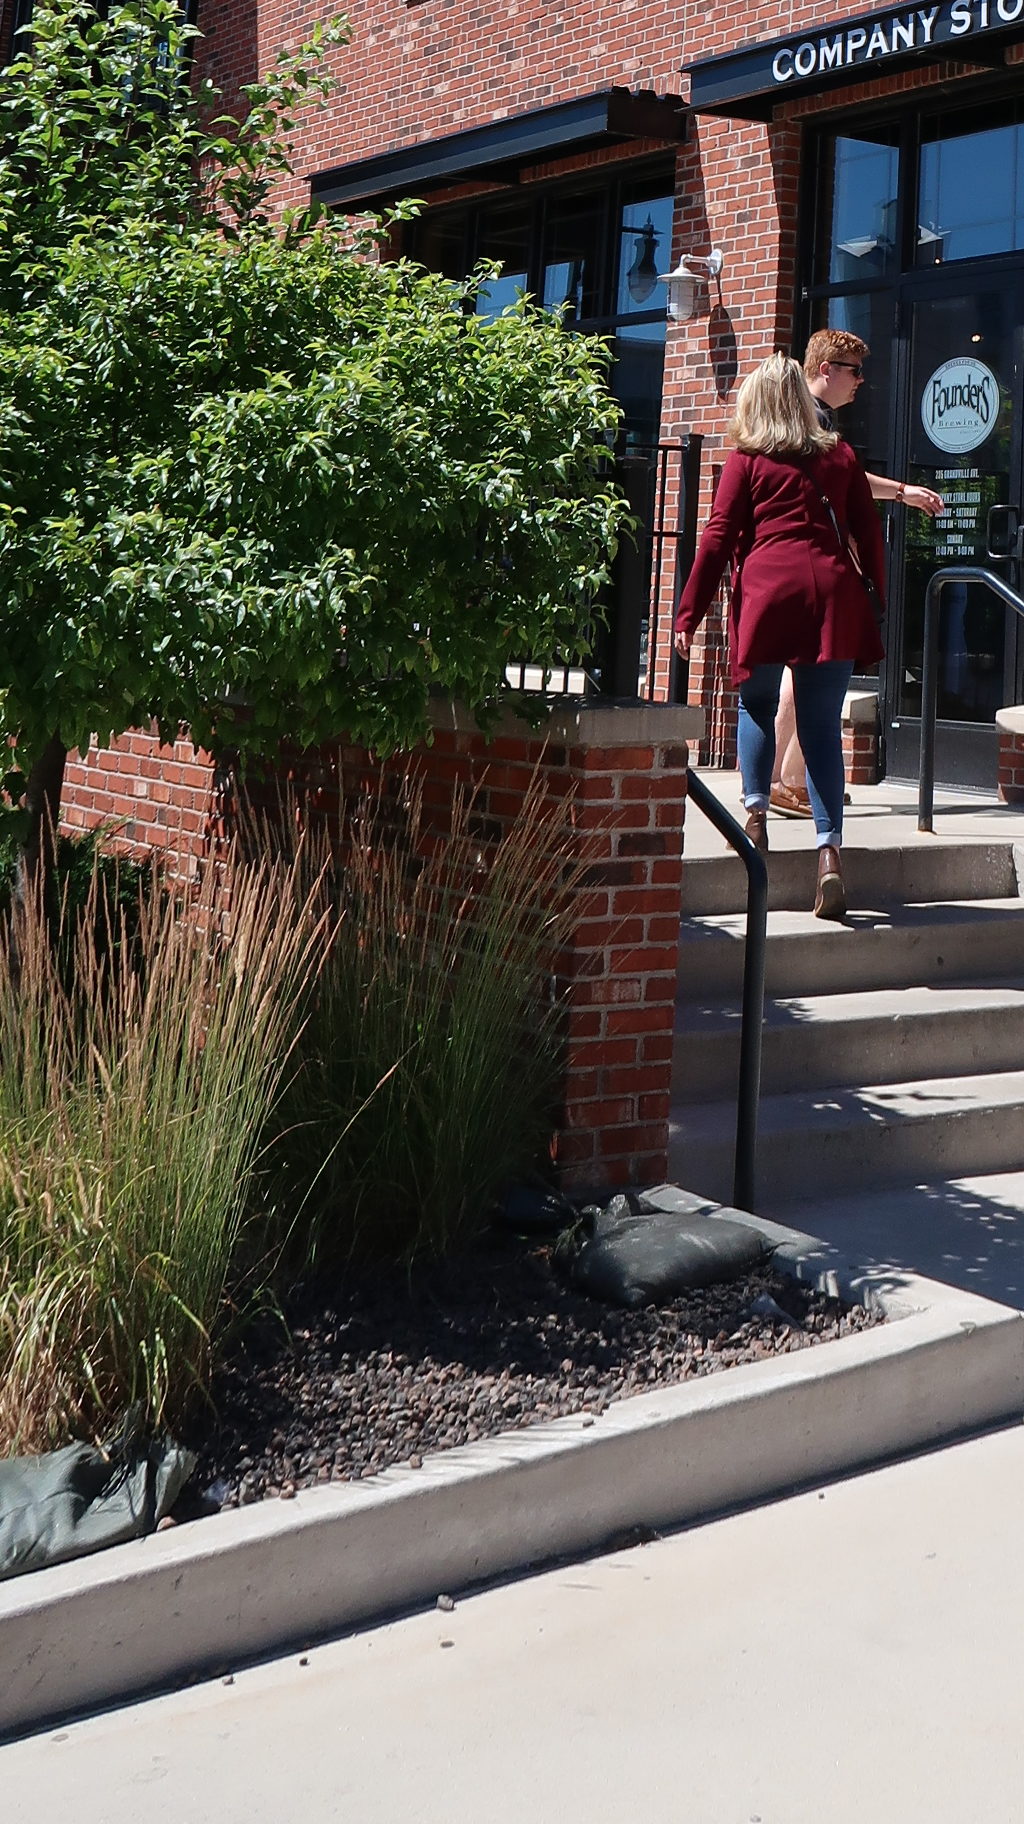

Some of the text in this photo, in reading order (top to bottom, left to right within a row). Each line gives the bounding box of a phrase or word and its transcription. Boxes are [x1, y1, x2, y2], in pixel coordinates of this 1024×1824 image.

[771, 5, 940, 82] COMPANY
[931, 374, 990, 427] Founders
[938, 418, 980, 427] Brewing
